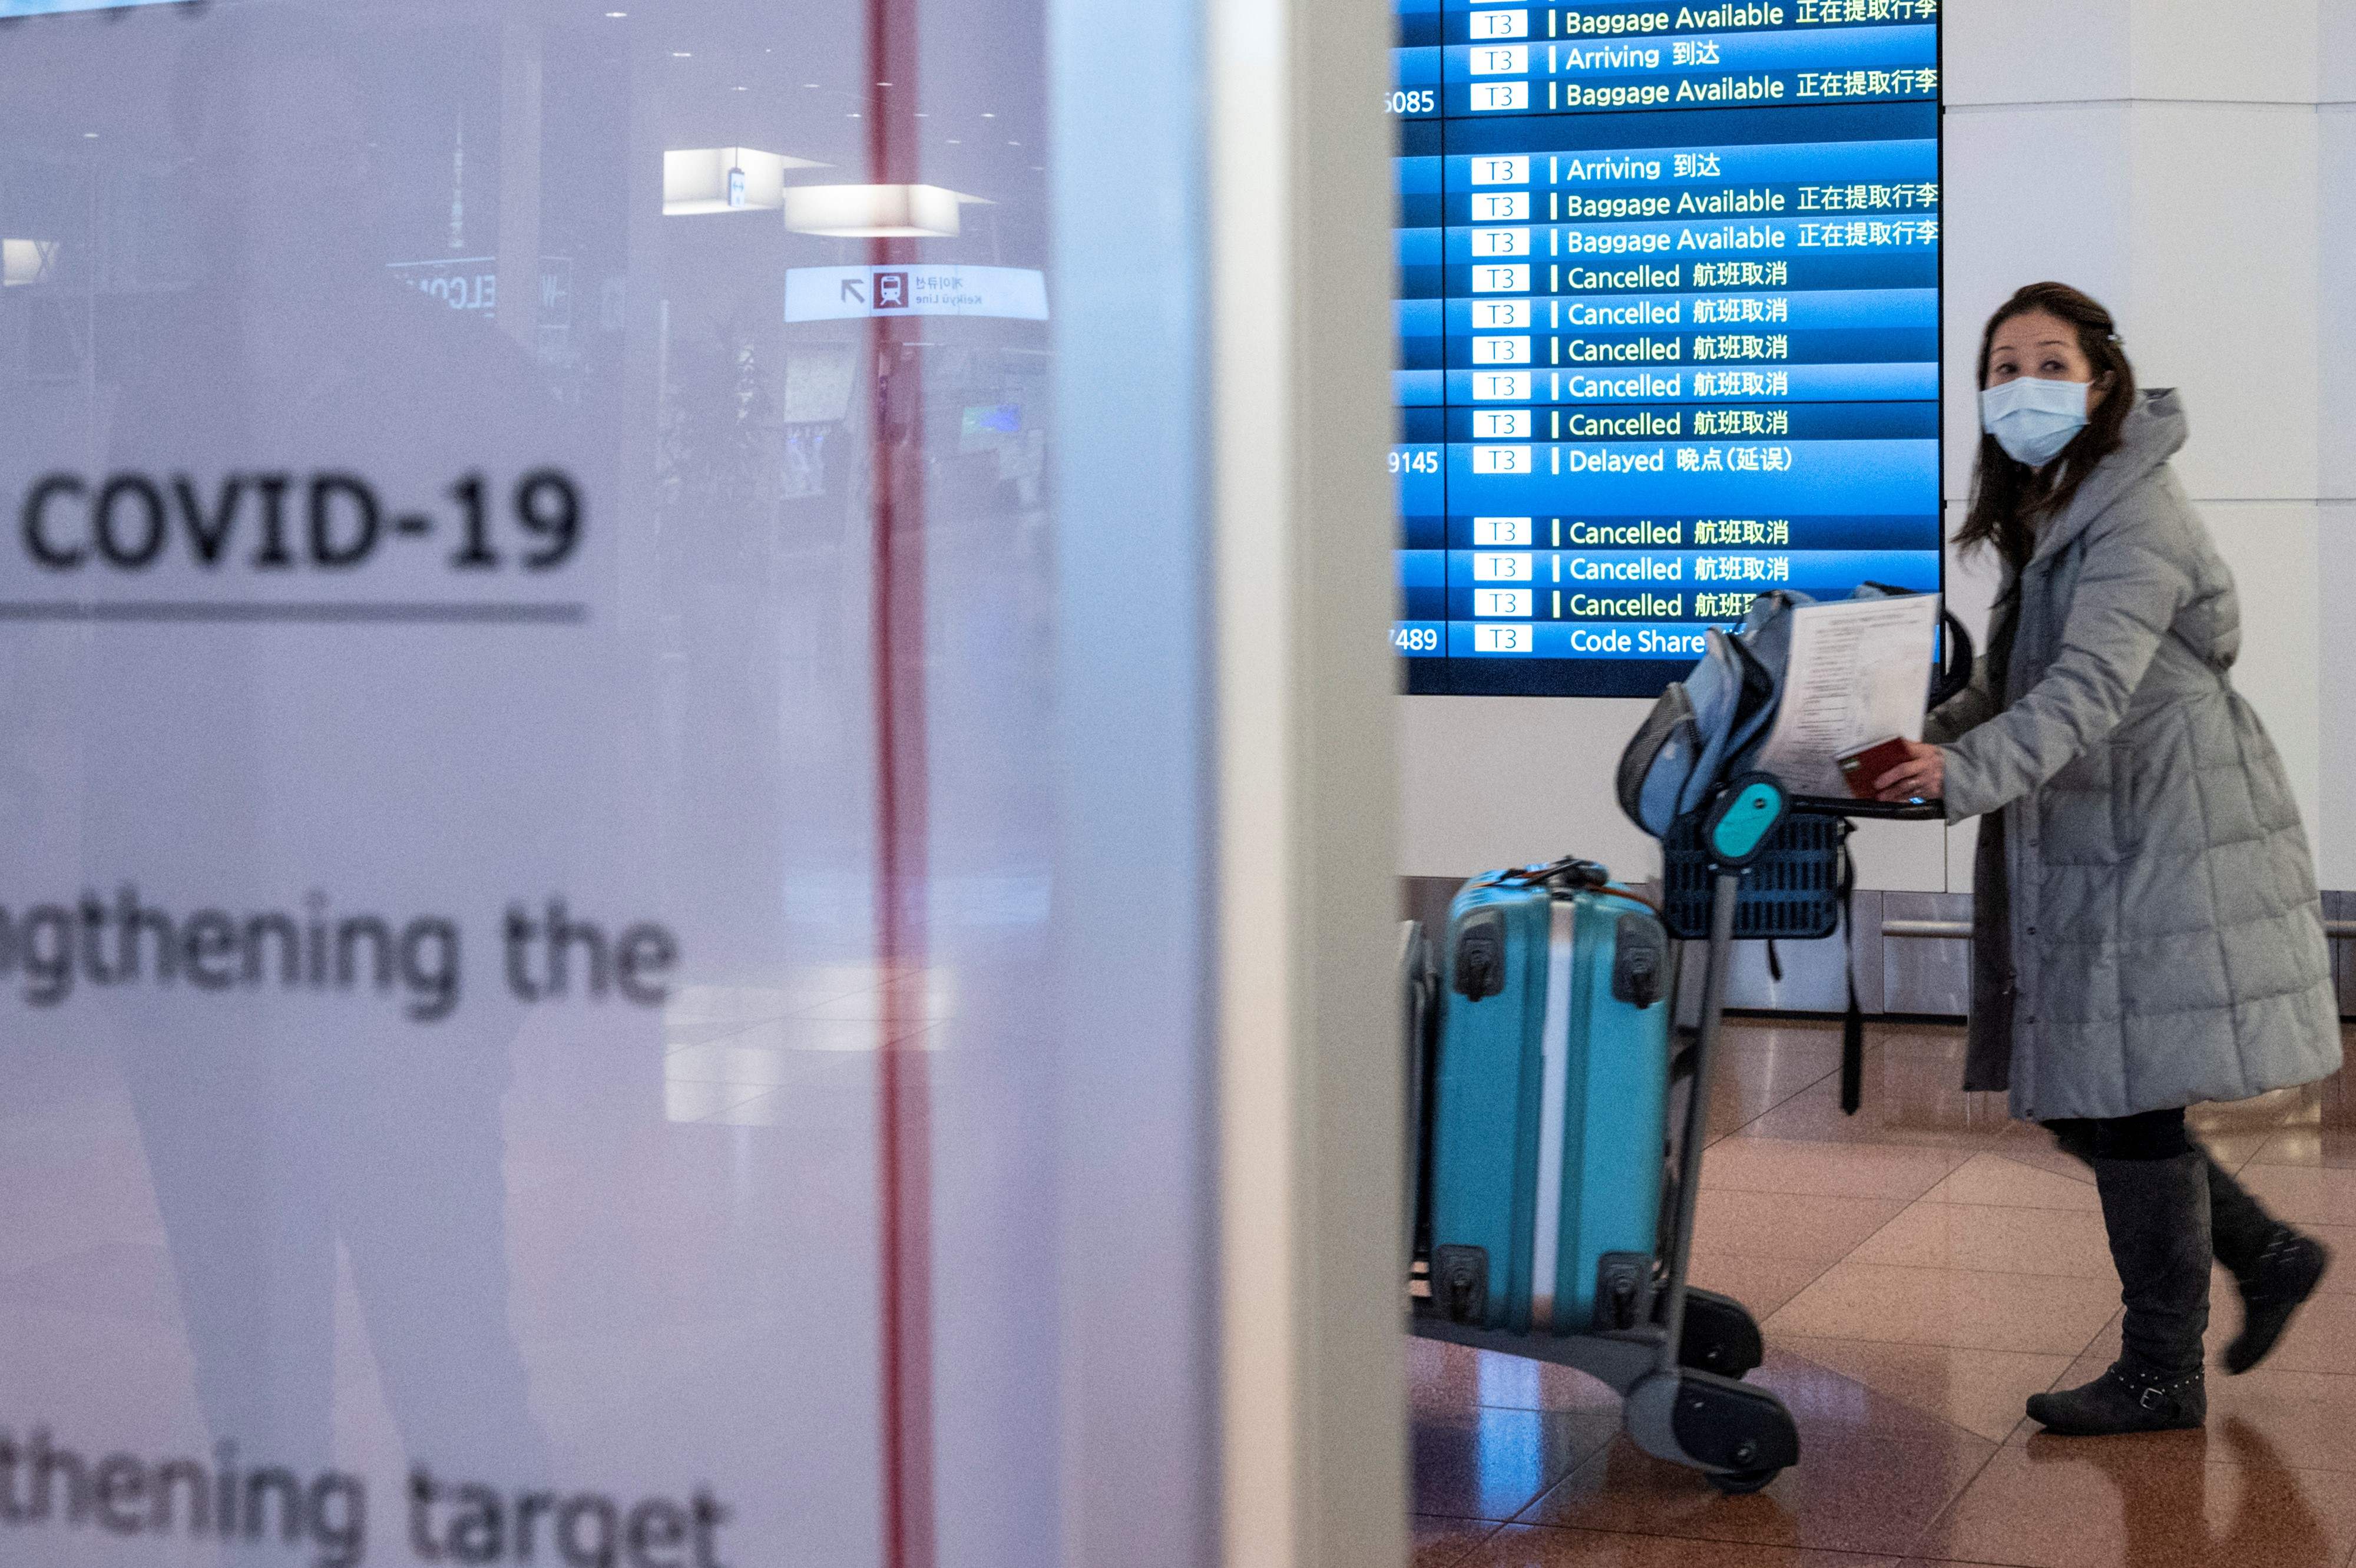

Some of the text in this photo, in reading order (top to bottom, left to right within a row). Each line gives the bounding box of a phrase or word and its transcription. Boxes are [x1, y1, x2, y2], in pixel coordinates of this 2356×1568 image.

[1485, 3, 1783, 35] T3 Baggage Available
[1485, 46, 1659, 71] T3 Arriving
[1673, 41, 1719, 65] 到达
[1486, 87, 1513, 107] T3
[1569, 85, 1669, 107] Baggage
[1677, 76, 1784, 101] Available
[1798, 69, 1937, 97] 正在提取行李
[1487, 157, 1660, 181] T3 Arriving
[1675, 153, 1720, 177] 到达
[1487, 190, 1785, 217] T3 Baggage Available
[1799, 183, 1937, 211] 正在提取行李
[1487, 226, 1785, 254] T3 Baggage Available
[1799, 220, 1937, 247] 正在提取行李
[1487, 265, 1680, 289] T3 Cancelled
[1694, 262, 1787, 287] 航班取消
[1488, 302, 1680, 325] T3 Cancelled
[1695, 298, 1787, 323] 航班取消
[1488, 338, 1680, 361] T3 Cancelled
[1695, 335, 1787, 360] 航班取消
[1488, 374, 1680, 398] T3 Cancelled
[1695, 371, 1788, 396] 航班取消
[1488, 413, 1680, 435] T3 Cancelled
[1695, 411, 1788, 435] 航班取消
[1388, 449, 1663, 474] 9145 T3 Delayed
[1678, 447, 1792, 472] 晚点(延误)
[21, 468, 584, 573] COVID-19
[1489, 522, 1681, 544] T3 Cancelled
[1695, 521, 1788, 544] 航班取消
[1489, 558, 1682, 580] T3 Cancelled
[1696, 557, 1789, 581] 航班取消
[1490, 594, 1682, 616] T3 Cancelled
[1490, 629, 1517, 650] T3
[1572, 630, 1632, 652] Code
[1639, 630, 1705, 653] Share
[504, 895, 681, 1008] the
[408, 1460, 732, 1568] target
